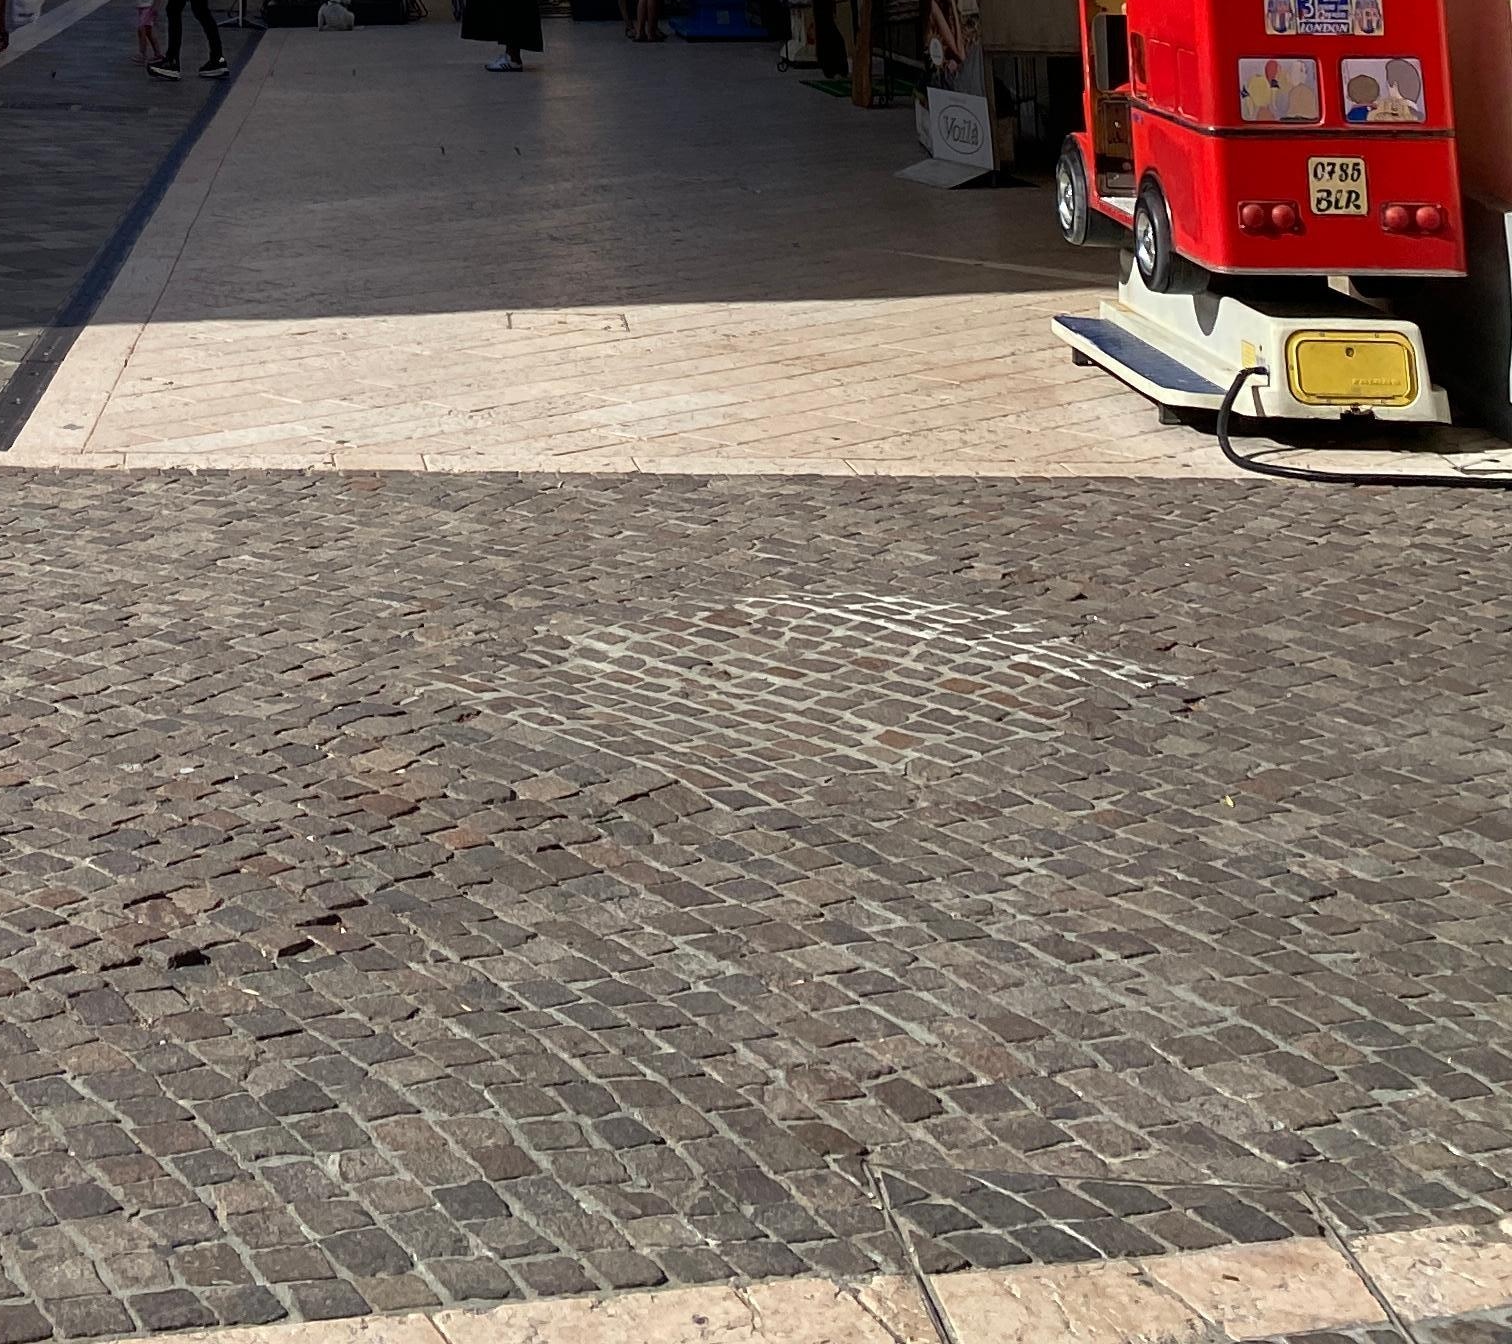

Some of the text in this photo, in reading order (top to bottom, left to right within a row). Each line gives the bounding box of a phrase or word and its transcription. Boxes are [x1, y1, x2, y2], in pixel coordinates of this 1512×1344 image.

[1300, 22, 1348, 33] LONDON
[943, 115, 979, 145] Voilà
[1313, 161, 1361, 182] 0785
